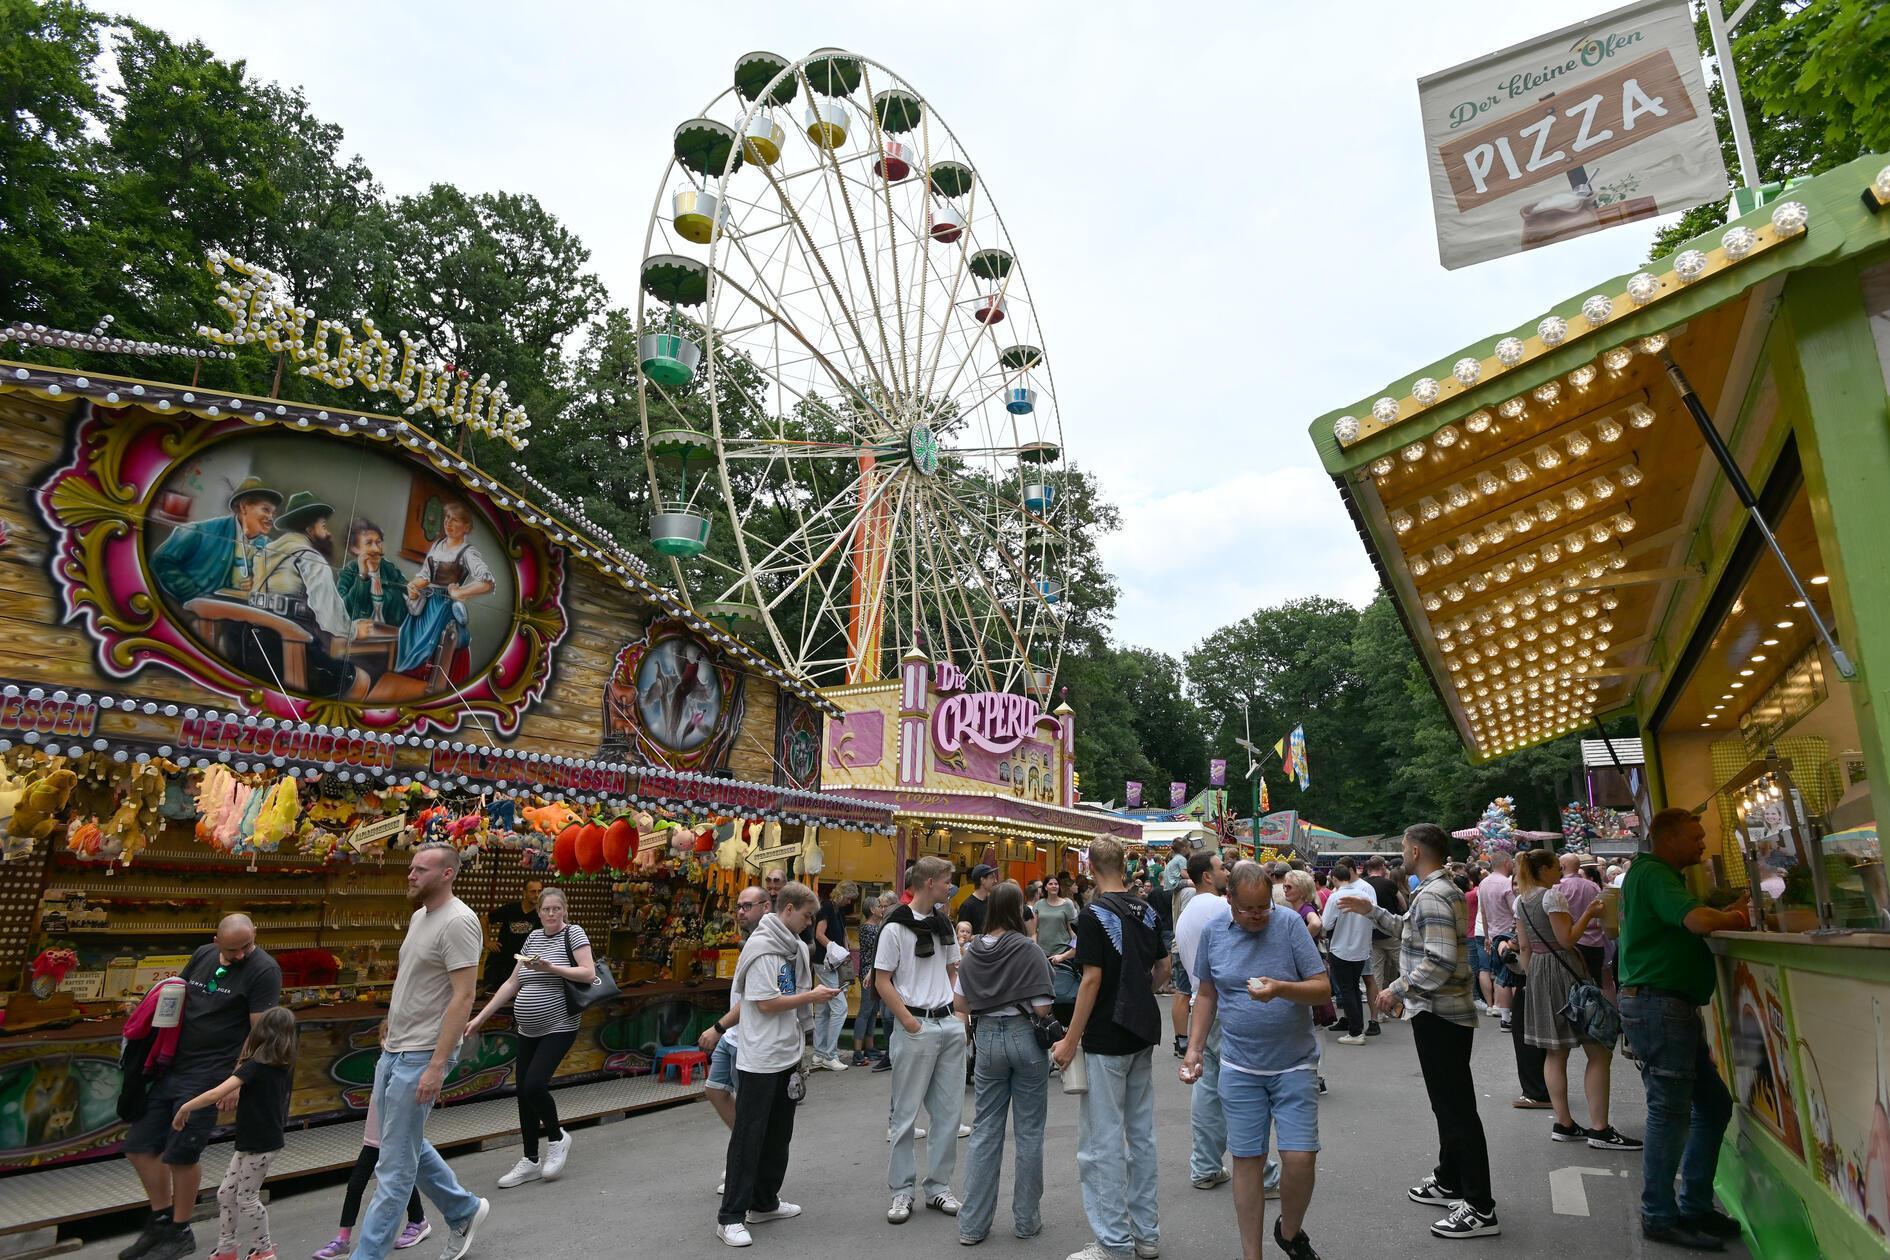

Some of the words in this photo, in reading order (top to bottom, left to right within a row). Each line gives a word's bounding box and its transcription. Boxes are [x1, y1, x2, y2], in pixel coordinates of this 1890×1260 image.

[1449, 93, 1500, 128] Der
[1498, 58, 1577, 99] kleine
[1580, 30, 1644, 68] Ofen
[1462, 78, 1668, 194] PIZZA
[937, 661, 967, 692] Die
[177, 717, 396, 771] HERZSCHIESSEN
[933, 692, 1040, 753] CREPERIE
[431, 746, 626, 796] WALZENSCHIESSEN
[638, 774, 779, 811] HERZSCHIESSEN
